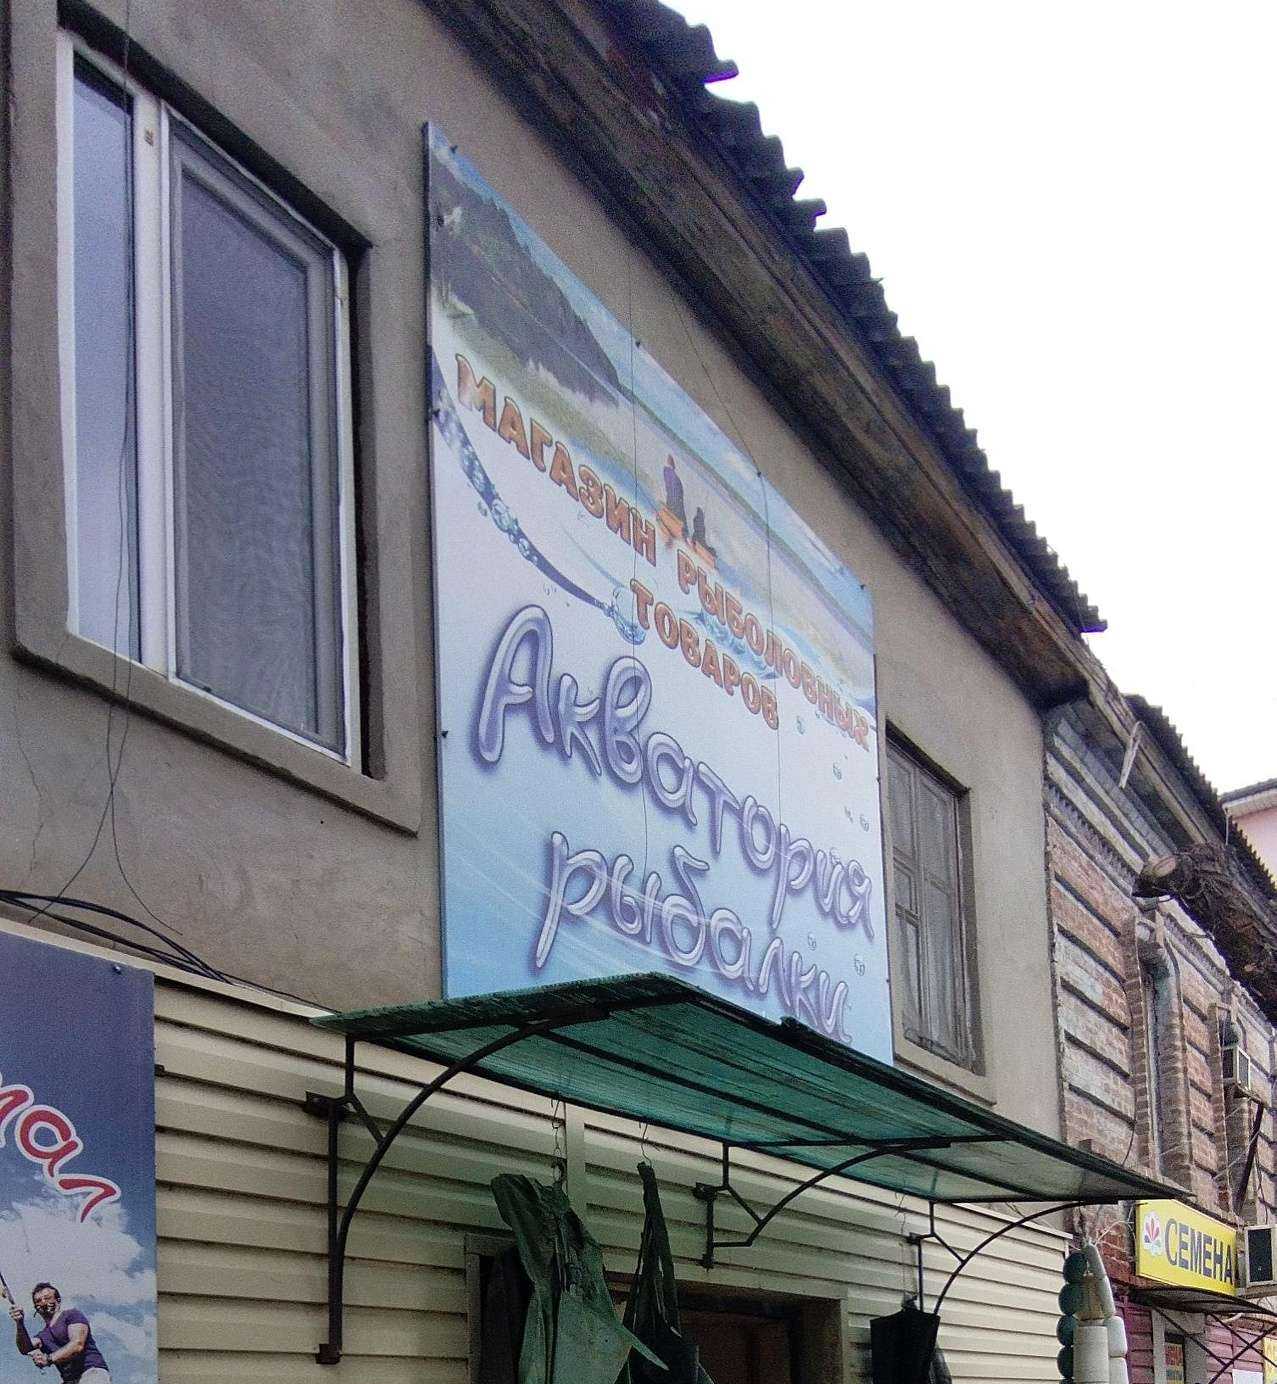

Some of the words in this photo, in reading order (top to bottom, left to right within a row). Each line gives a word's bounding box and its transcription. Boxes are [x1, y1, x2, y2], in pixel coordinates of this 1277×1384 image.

[455, 352, 657, 567] МАГАЗИН
[677, 548, 870, 752] РЫБОЛОВНЫХ
[629, 578, 779, 731] ТОВАРОВ
[477, 603, 875, 938] Акватория
[535, 830, 853, 1044] рыбалки
[1164, 1218, 1234, 1286] СЕМЕНА
